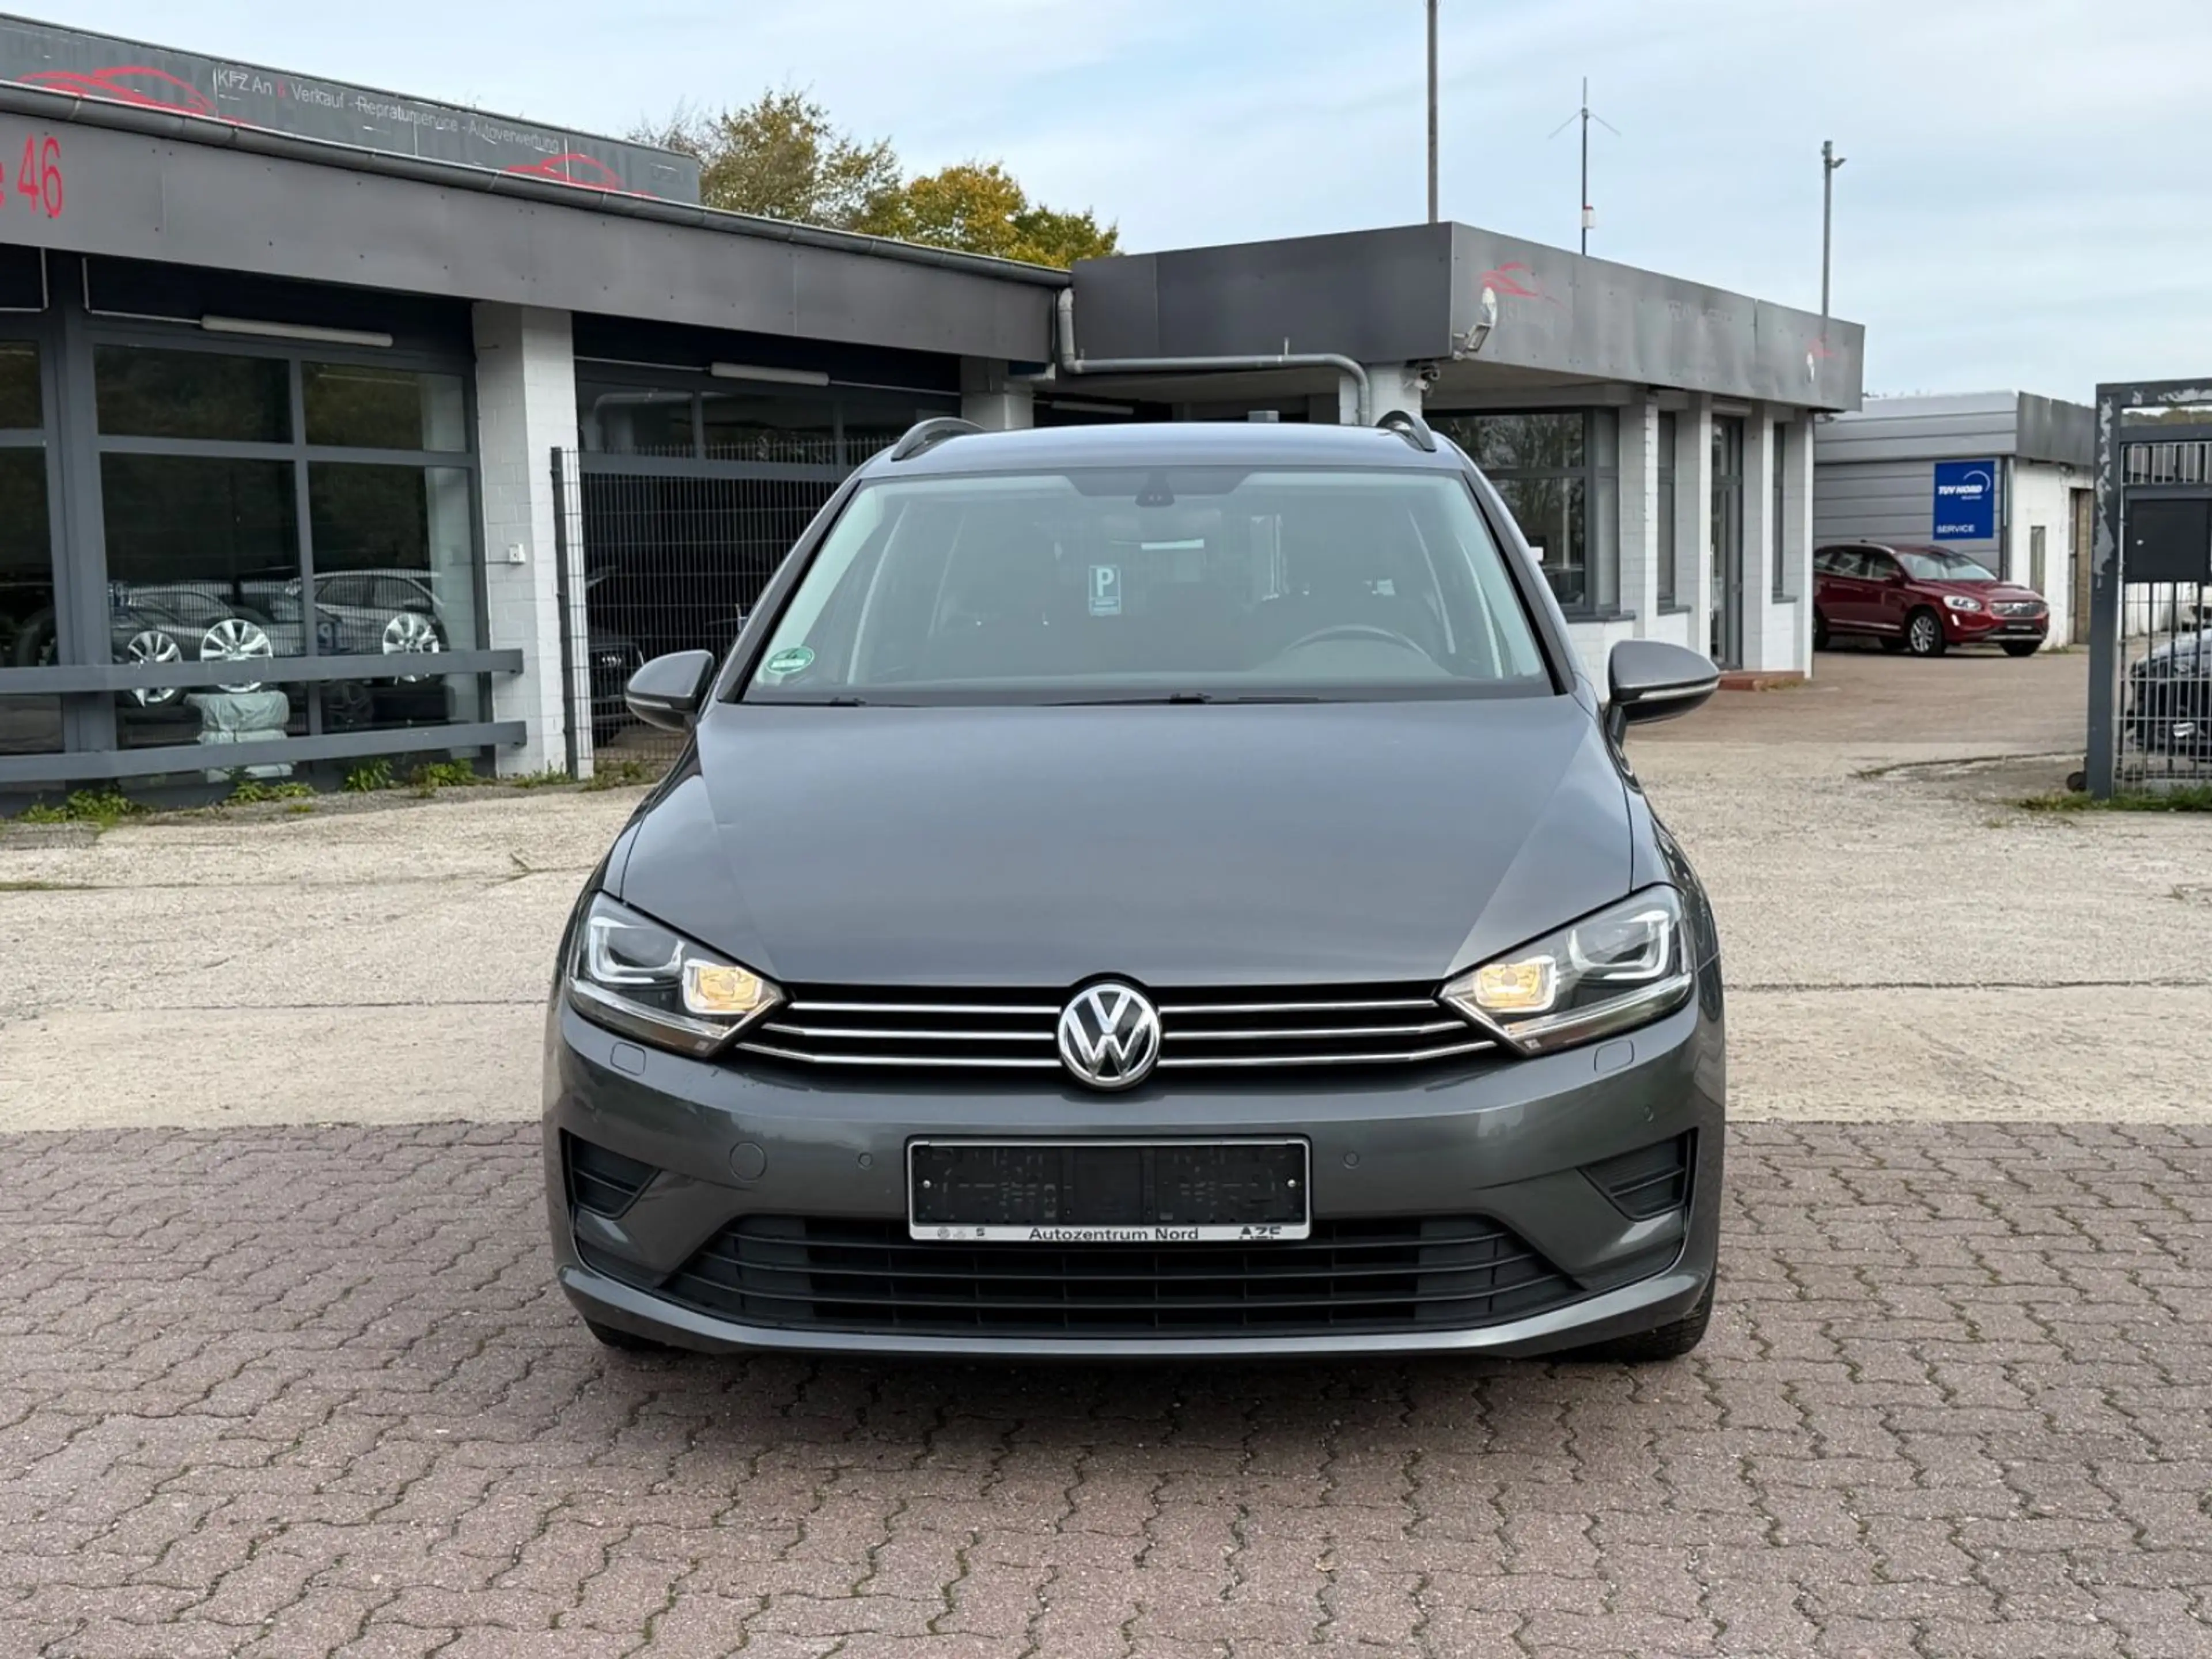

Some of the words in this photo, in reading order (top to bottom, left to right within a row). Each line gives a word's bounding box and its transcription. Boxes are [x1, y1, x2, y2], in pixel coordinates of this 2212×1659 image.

[218, 68, 249, 91] KFZ
[252, 76, 272, 95] An
[17, 132, 63, 219] 46
[1937, 524, 1975, 535] SERVICE
[1096, 567, 1115, 597] P
[1059, 983, 1160, 1088] VW
[1029, 1227, 1148, 1240] Autozentrum
[1155, 1226, 1199, 1240] Nord
